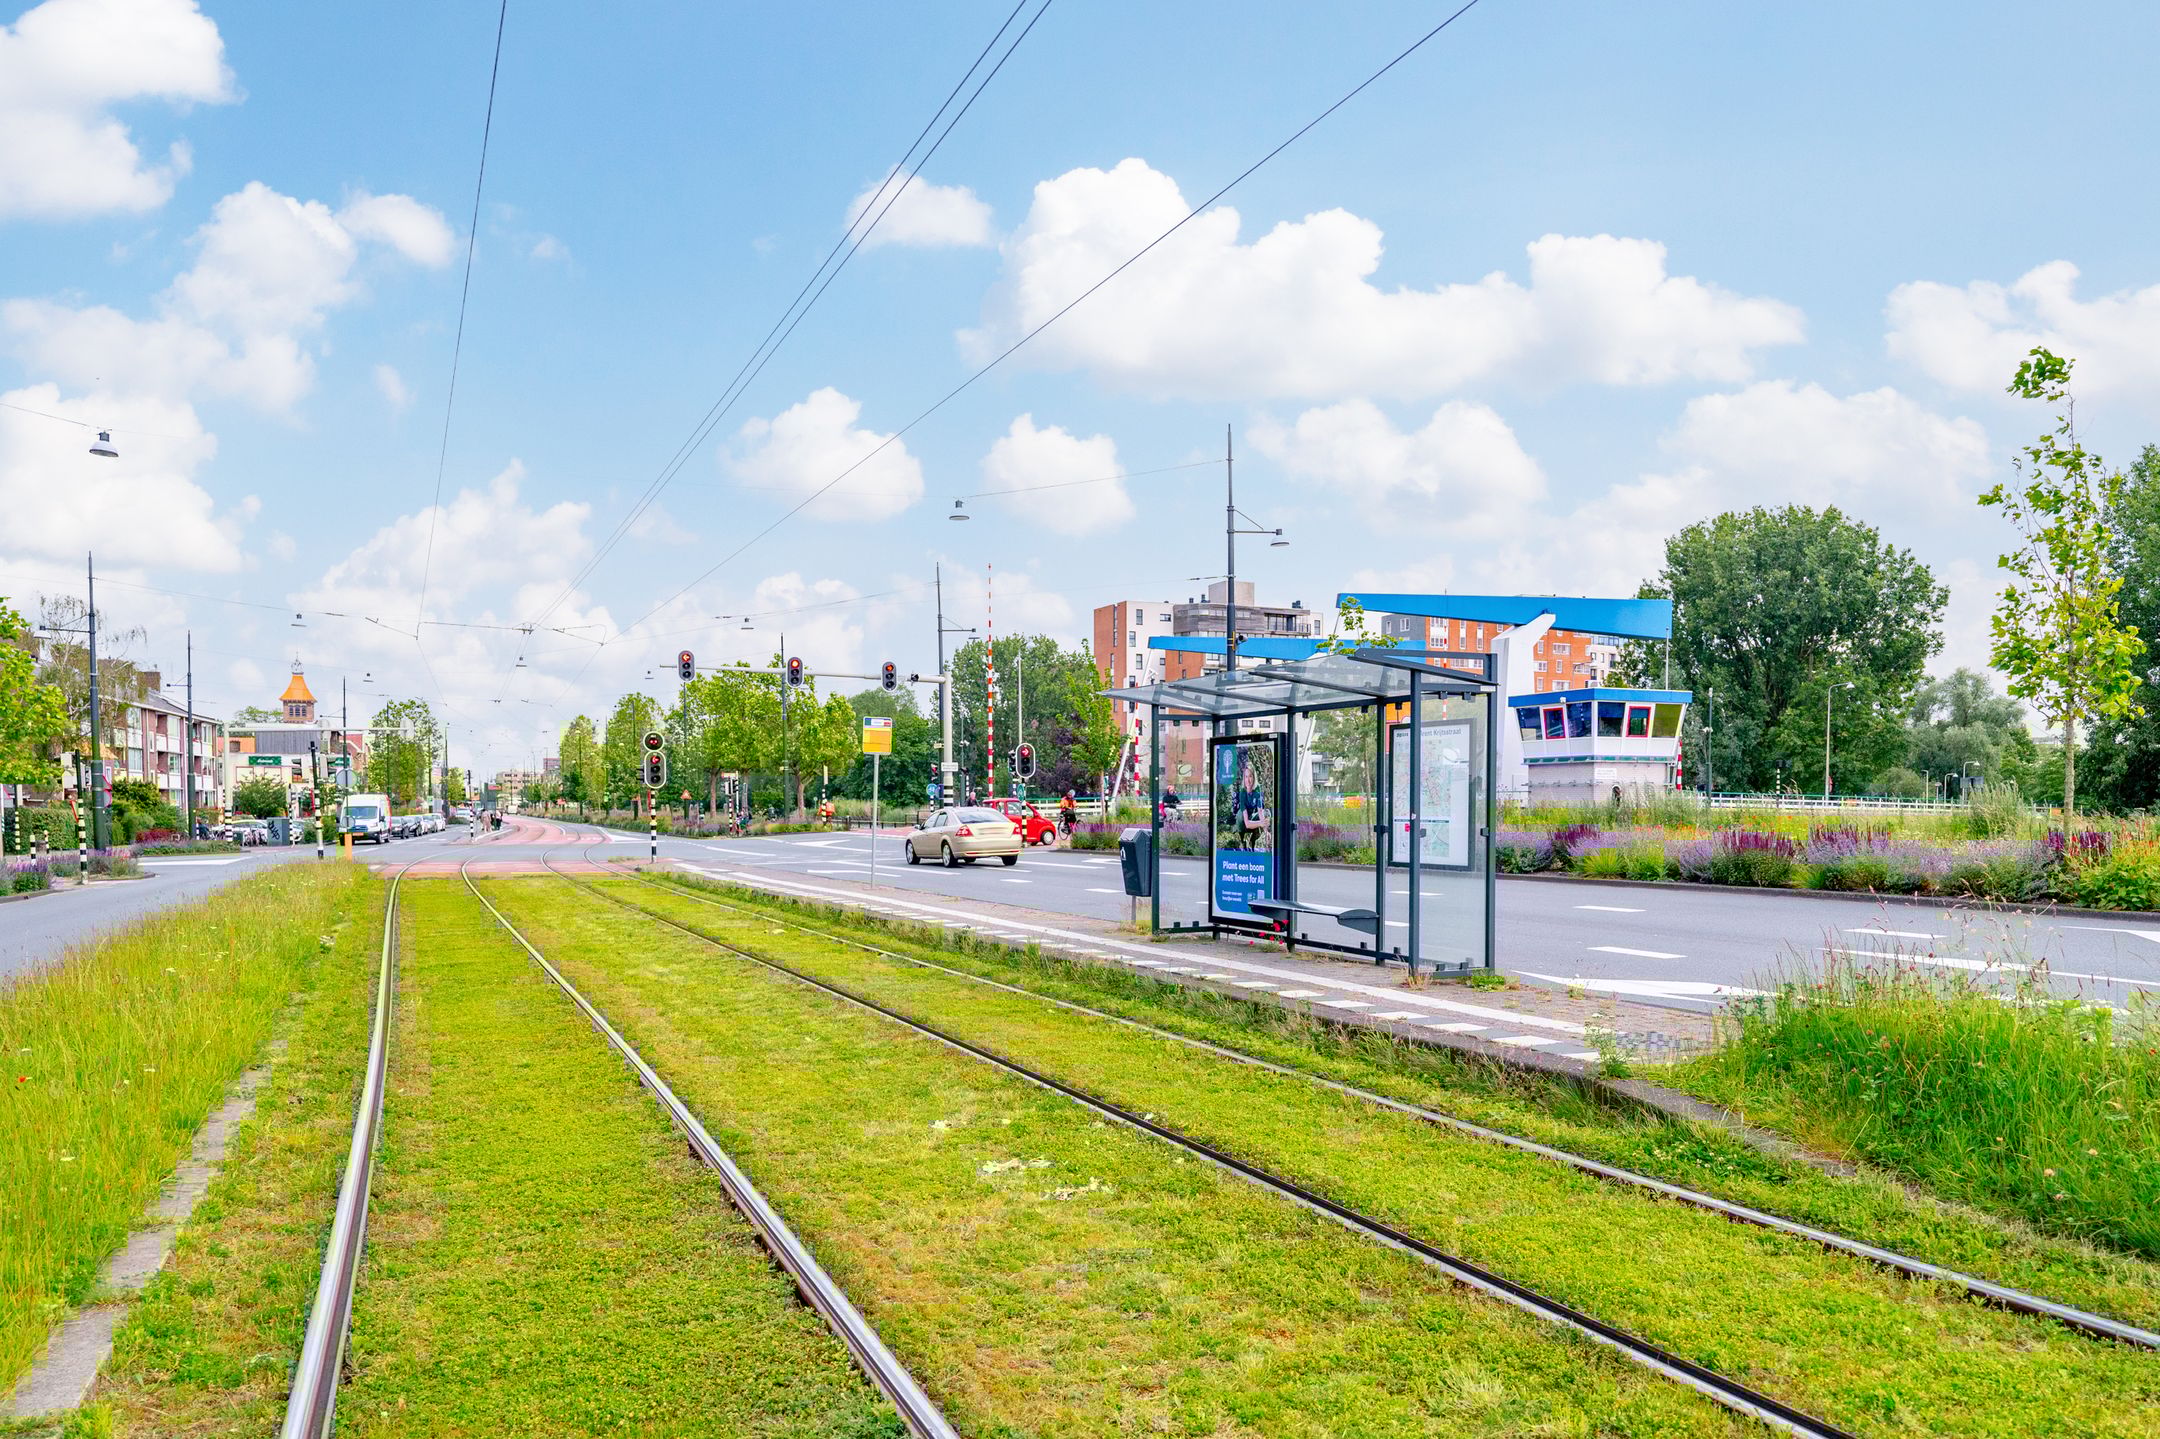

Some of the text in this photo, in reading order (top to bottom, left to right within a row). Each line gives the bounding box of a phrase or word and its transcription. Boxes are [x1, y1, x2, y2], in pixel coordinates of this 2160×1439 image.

[1222, 860, 1238, 870] Plant
[1249, 862, 1264, 871] boom
[1234, 874, 1248, 882] Trees
